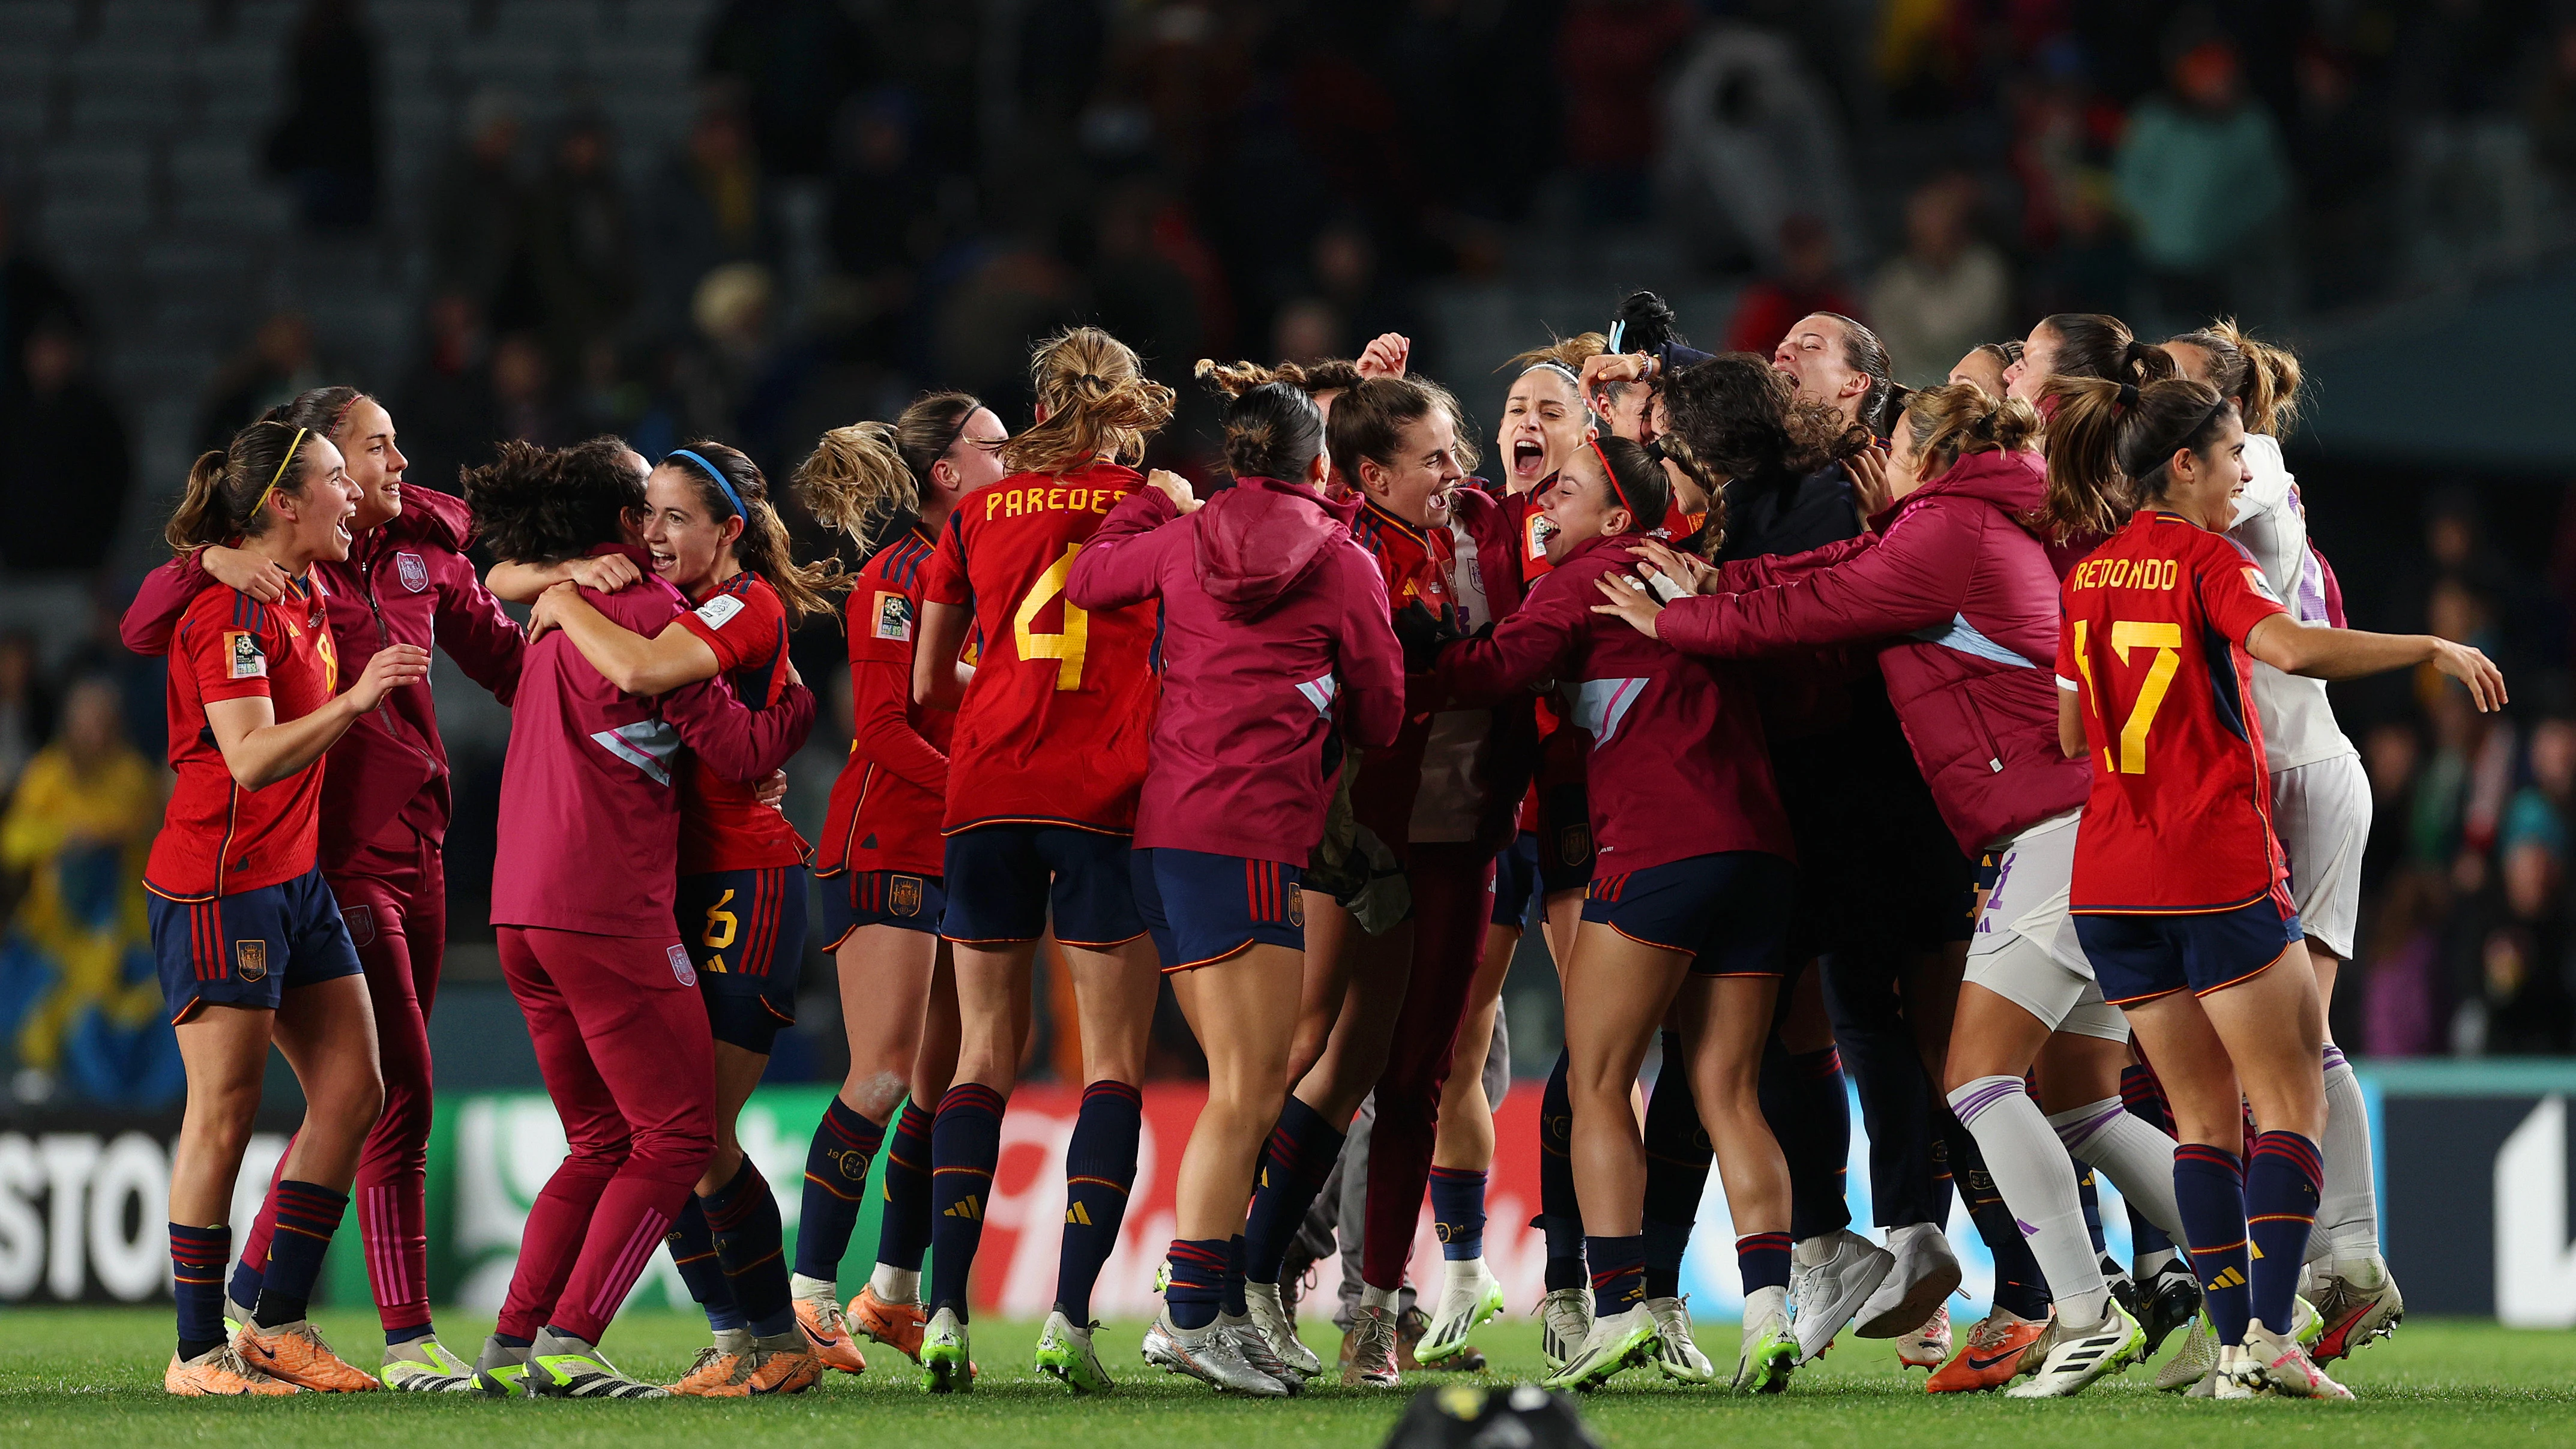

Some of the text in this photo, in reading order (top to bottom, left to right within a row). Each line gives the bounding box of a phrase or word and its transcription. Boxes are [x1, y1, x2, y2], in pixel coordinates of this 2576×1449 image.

[2073, 559, 2178, 592] REDONDO
[1014, 543, 1088, 691] 4
[317, 633, 336, 693] 8
[2074, 619, 2182, 774] 17
[702, 889, 738, 948] 6
